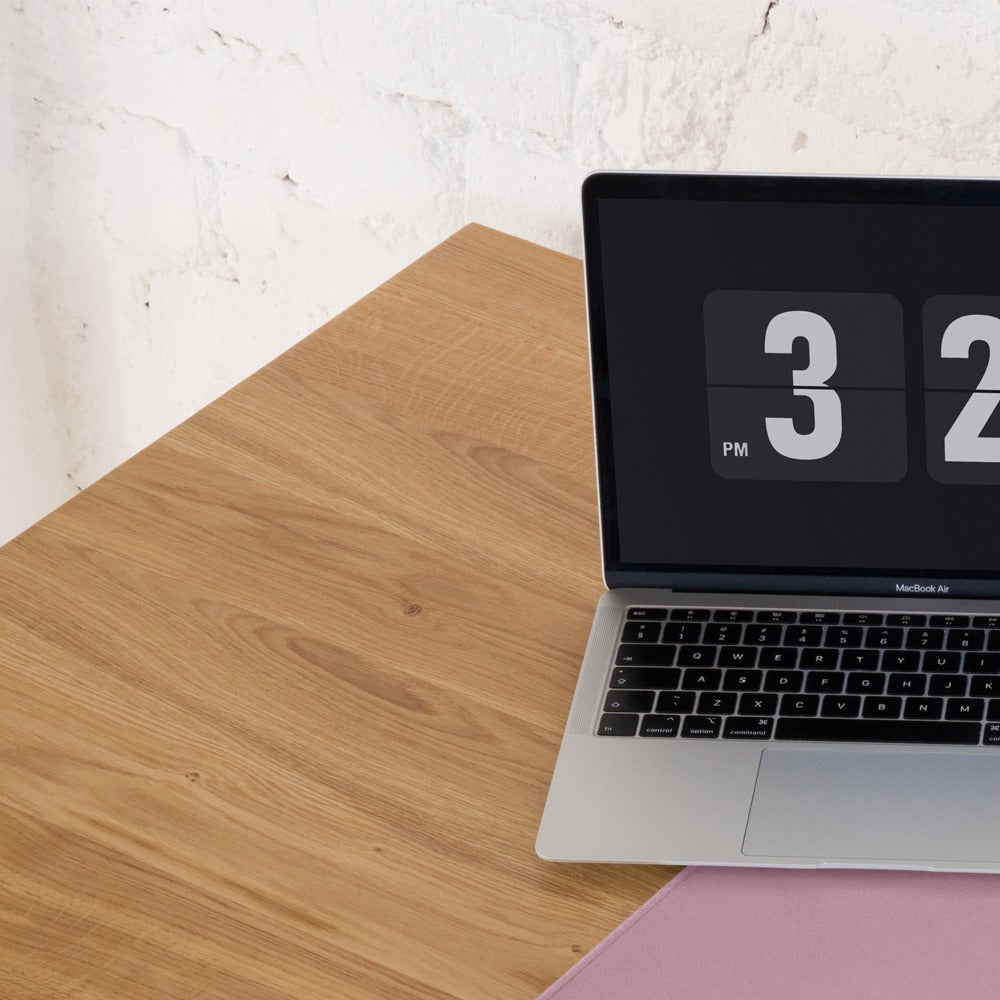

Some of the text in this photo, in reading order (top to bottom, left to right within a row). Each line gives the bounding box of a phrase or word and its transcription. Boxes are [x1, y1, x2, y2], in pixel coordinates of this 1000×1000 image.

[764, 310, 842, 460] 3
[722, 442, 748, 457] PM
[896, 584, 950, 593] MacBook Air
